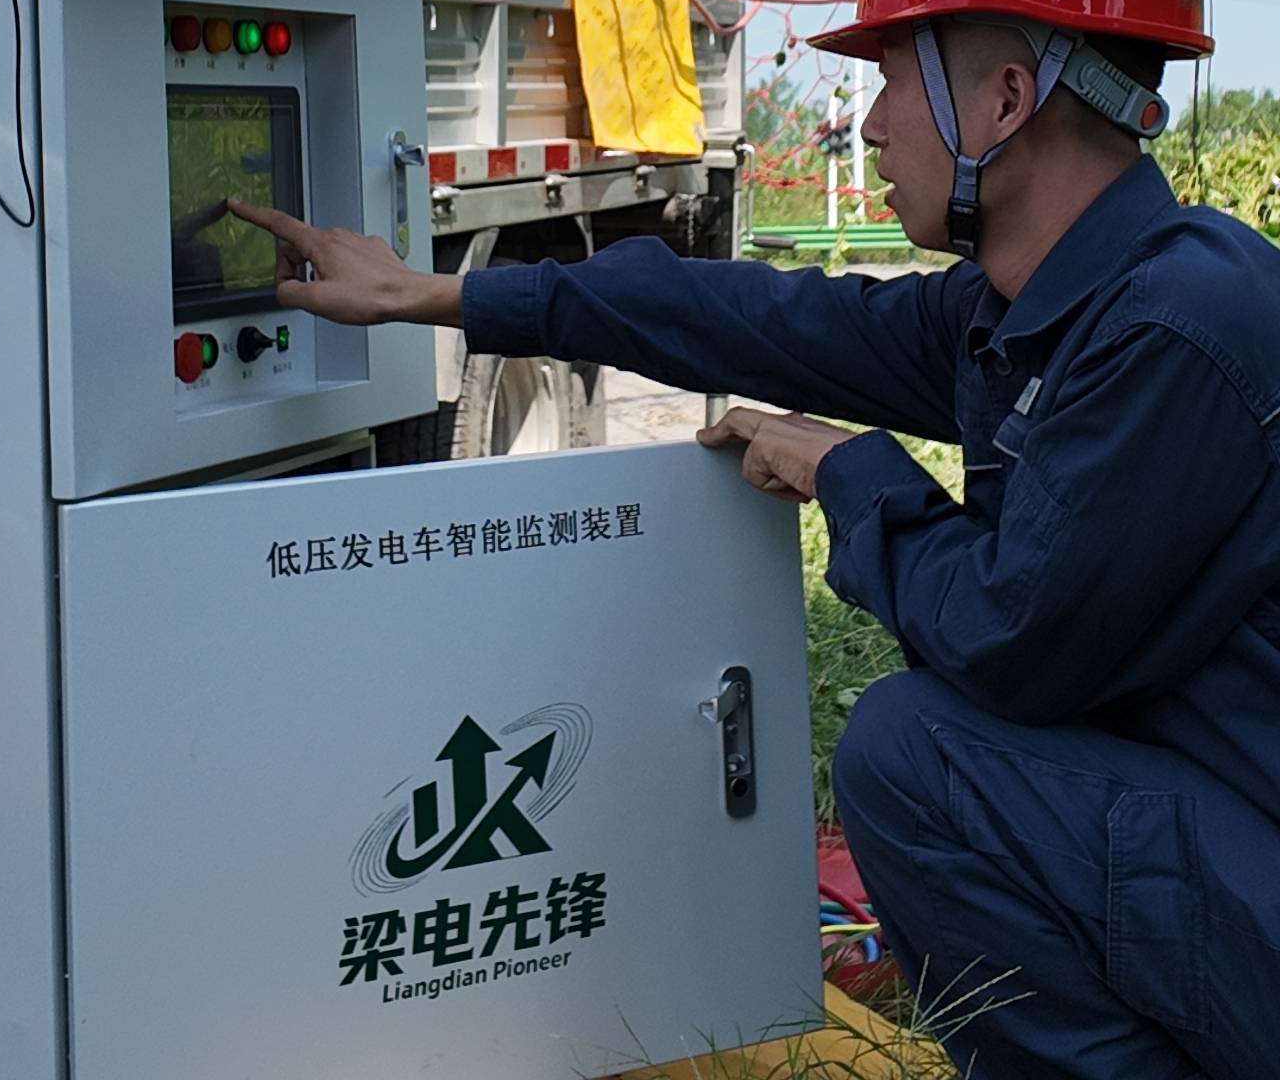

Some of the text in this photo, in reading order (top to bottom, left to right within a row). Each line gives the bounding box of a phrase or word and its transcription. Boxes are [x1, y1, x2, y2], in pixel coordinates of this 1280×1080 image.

[266, 503, 645, 578] 低压发电车智能监测装置
[339, 872, 607, 986] 梁电先锋
[382, 950, 573, 1003] Liangdian Pioneer
